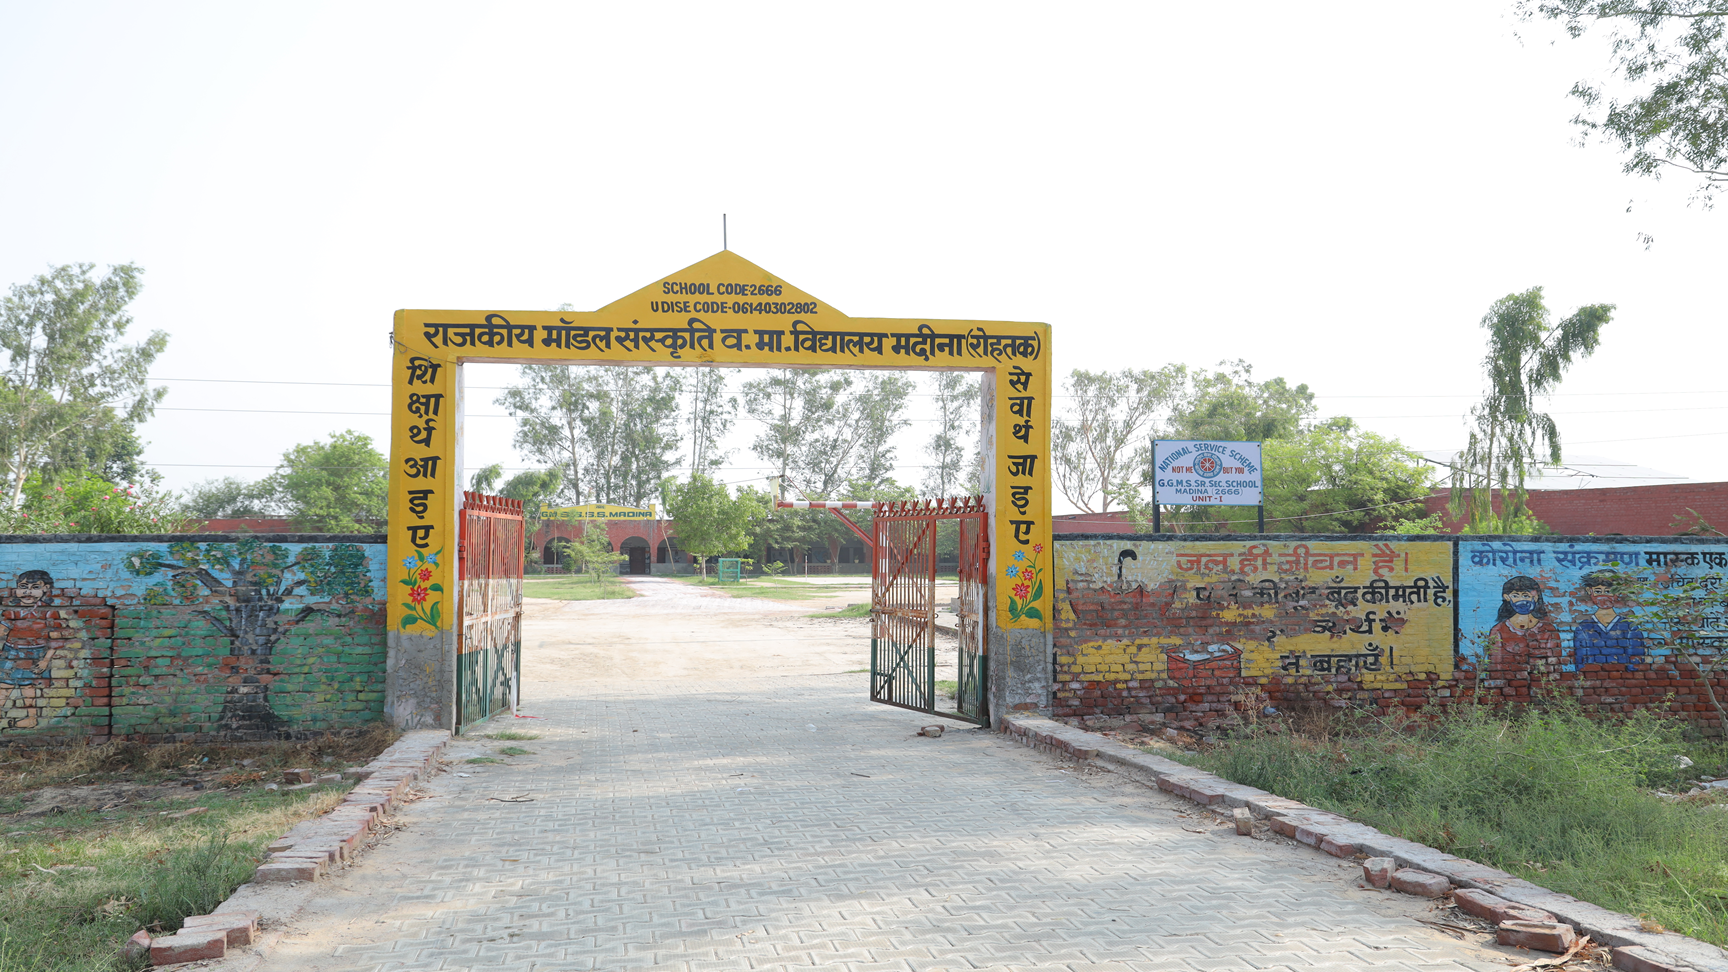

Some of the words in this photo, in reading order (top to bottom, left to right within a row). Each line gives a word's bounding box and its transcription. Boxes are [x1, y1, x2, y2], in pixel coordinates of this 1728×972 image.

[662, 281, 714, 295] SCHOOL
[423, 313, 537, 349] राजकीय
[541, 317, 613, 353] मॉडल
[615, 317, 717, 359] संस्कृति
[891, 323, 966, 362] मदीना
[1158, 446, 1193, 473] NATIONAL
[1193, 443, 1227, 455] SERVICE
[1228, 449, 1259, 475] SCHEME
[1171, 466, 1184, 474] NOT
[1185, 466, 1194, 474] ME
[1222, 466, 1233, 474] BUT
[1234, 467, 1245, 475] YOU
[1211, 488, 1243, 496] (2666)
[1238, 544, 1273, 577] ही
[1278, 543, 1365, 574] जीवन
[1470, 542, 1546, 568] कोरोना
